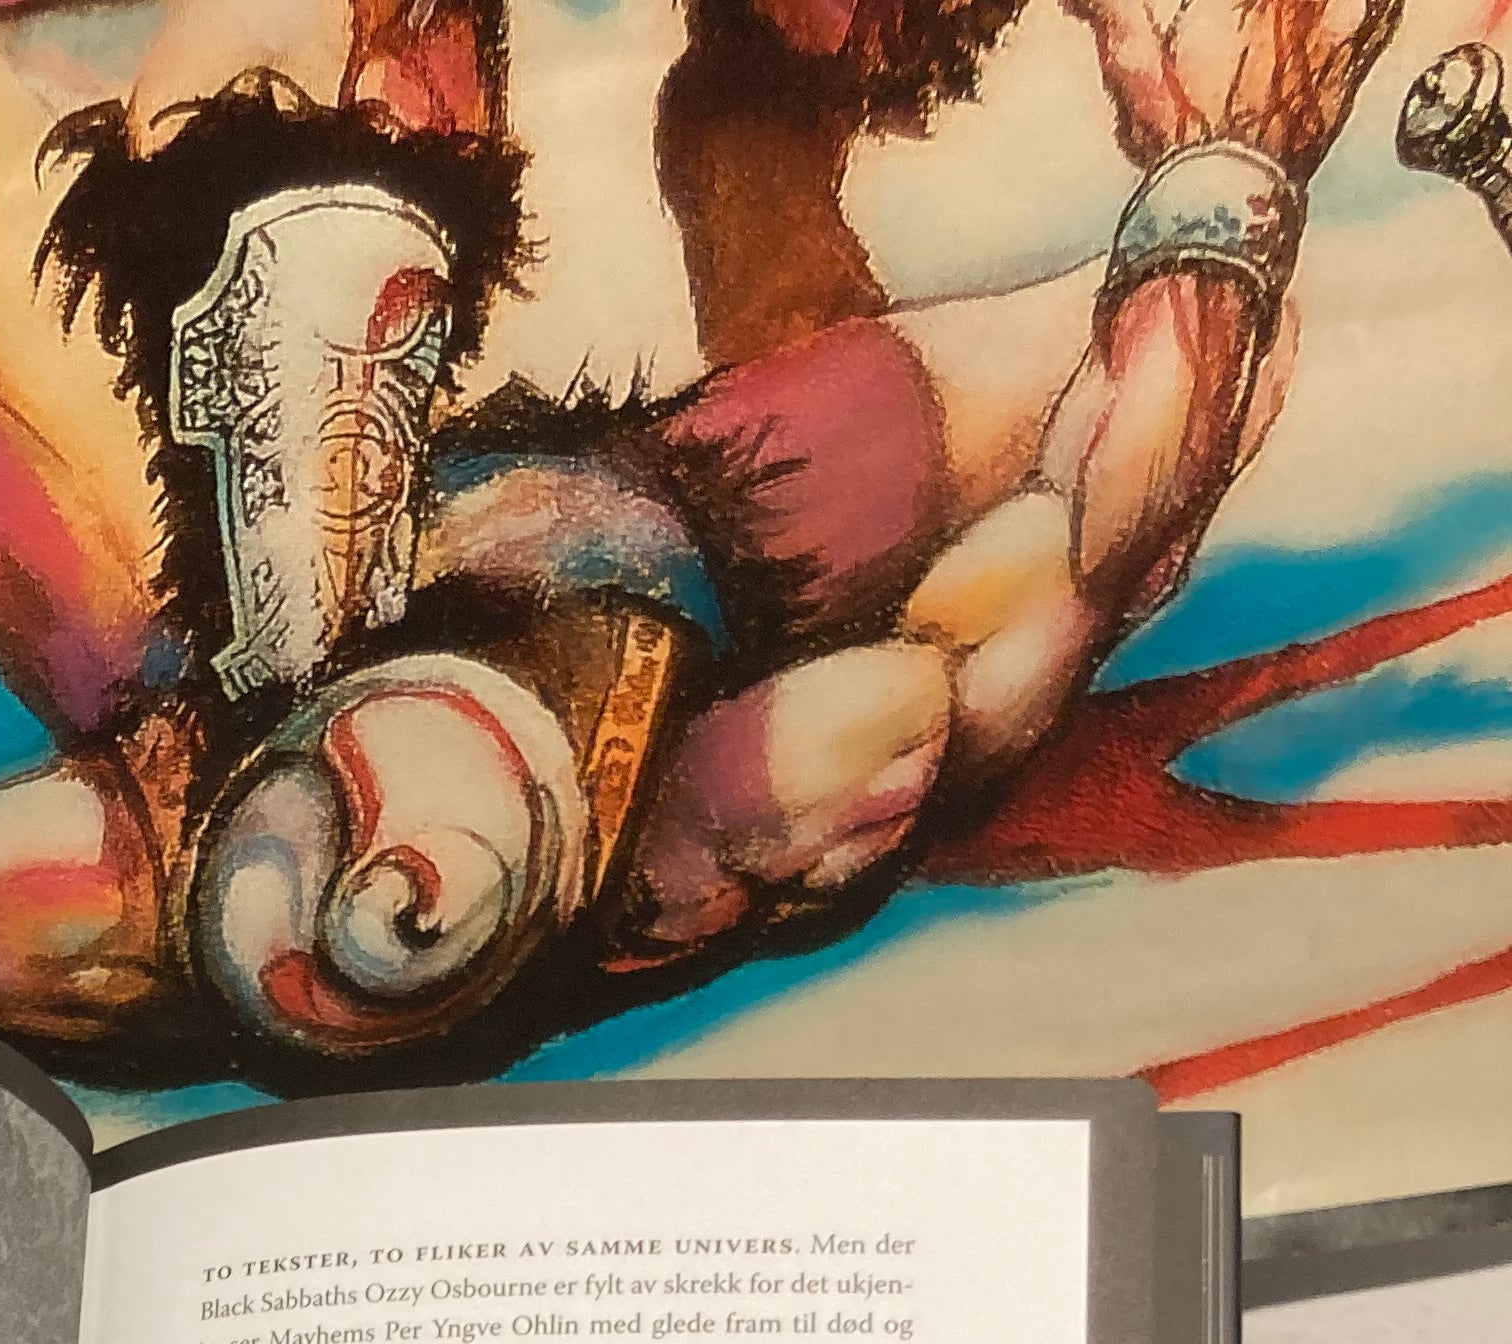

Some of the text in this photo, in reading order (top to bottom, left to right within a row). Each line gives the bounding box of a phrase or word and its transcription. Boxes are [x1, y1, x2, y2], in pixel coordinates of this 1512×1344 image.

[202, 1232, 916, 1283] TO TEKSTER, TO FLIKER AV SAMME UNIVERS. Men der
[200, 1271, 913, 1321] Black Sabbaths Ozzy Osbourne er fylt av skrekk for det ukjen-
